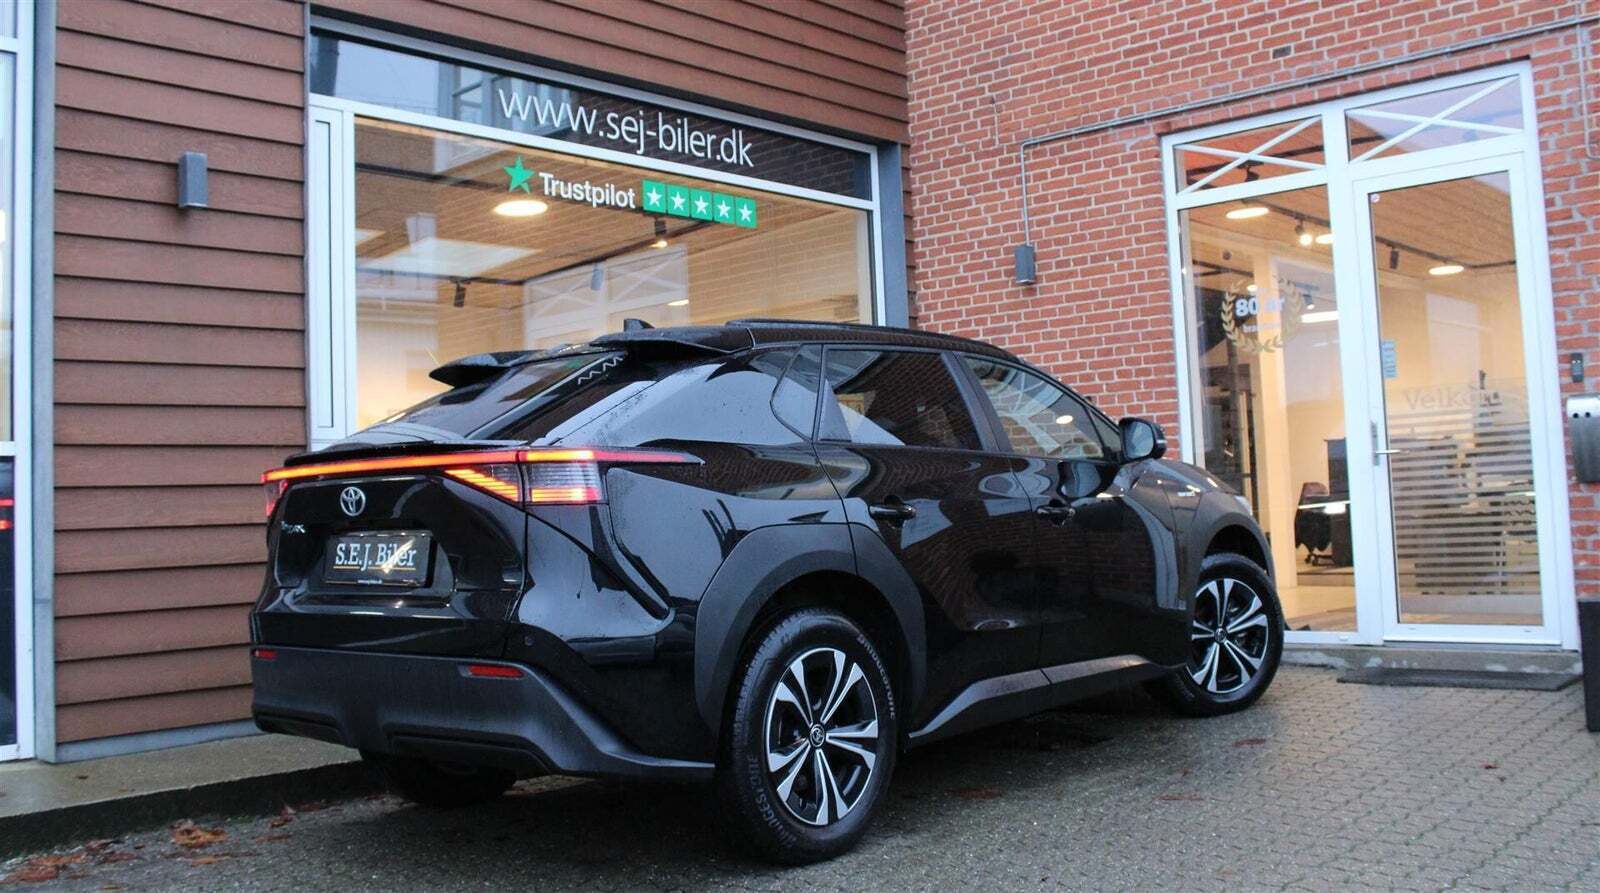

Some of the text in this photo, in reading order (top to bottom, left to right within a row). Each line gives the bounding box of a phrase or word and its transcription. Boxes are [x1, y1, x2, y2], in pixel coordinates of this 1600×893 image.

[499, 88, 754, 168] www.sej-biler.dk
[538, 171, 636, 209] Trustpilot
[1235, 297, 1259, 317] 80
[335, 543, 417, 571] S.E.J. Biler
